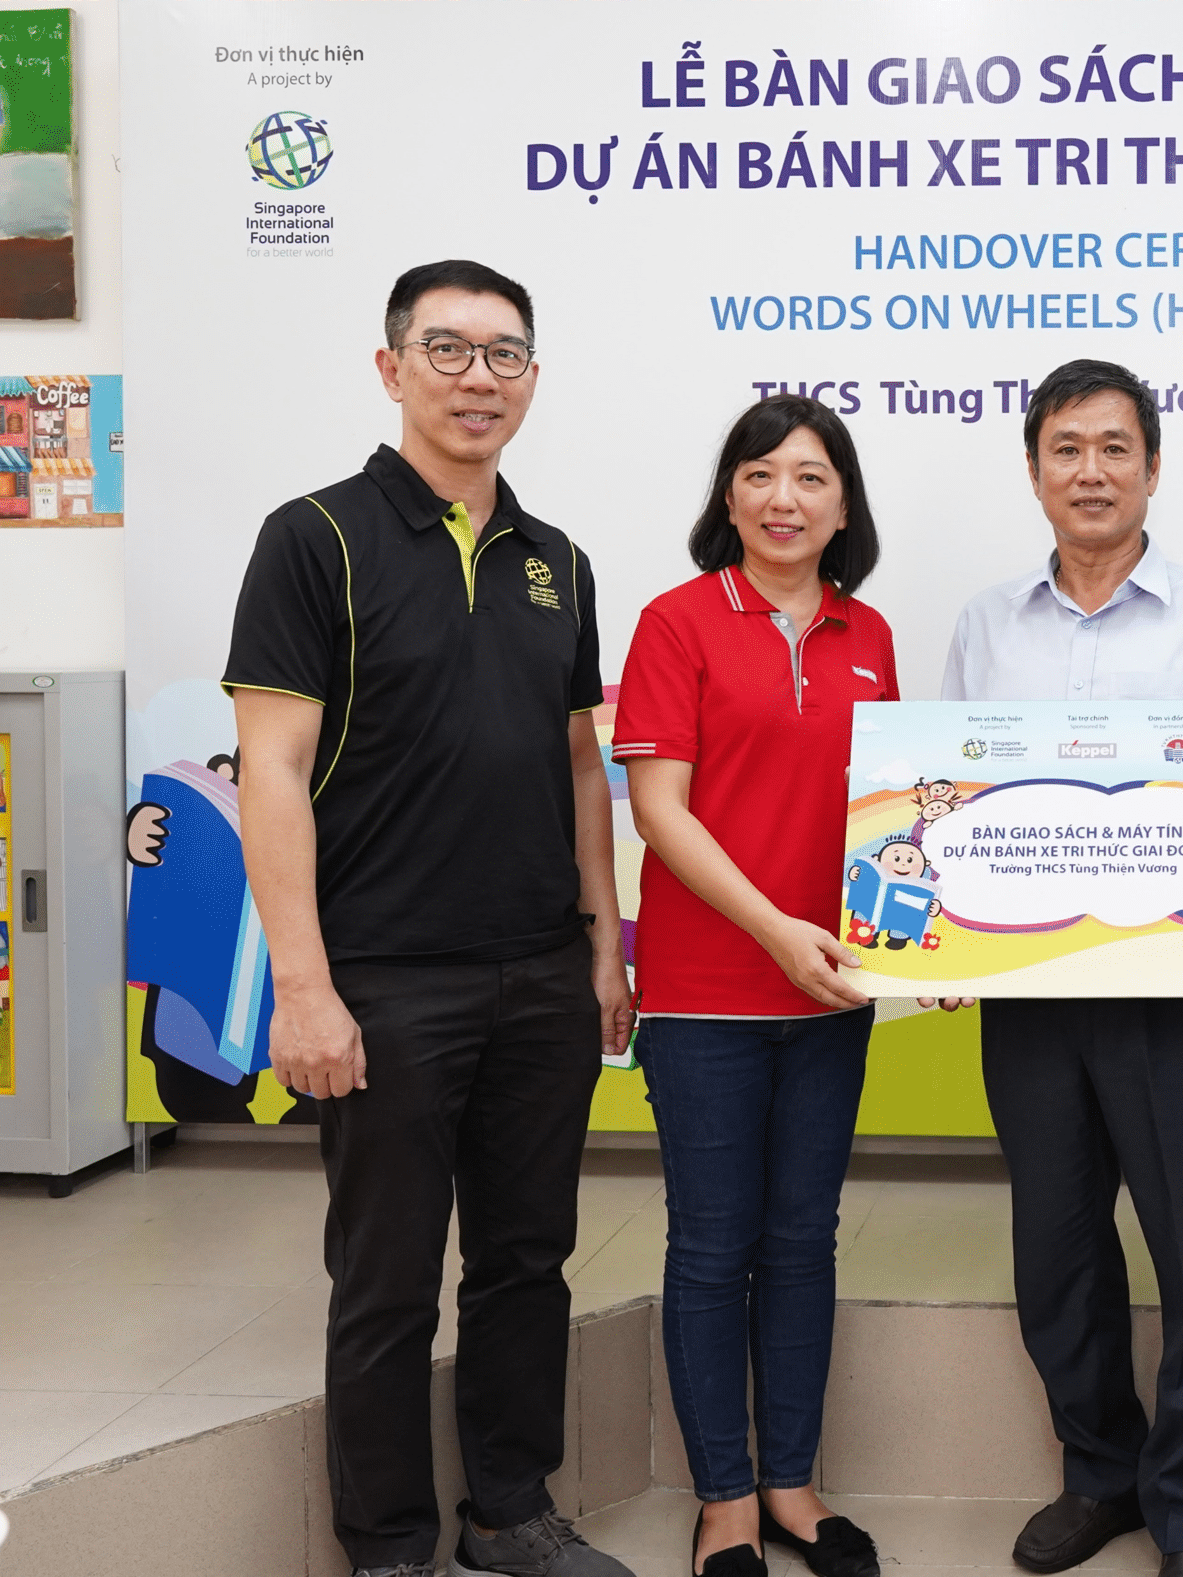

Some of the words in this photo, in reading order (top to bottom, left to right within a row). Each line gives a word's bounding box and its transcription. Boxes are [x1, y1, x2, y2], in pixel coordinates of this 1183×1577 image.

[215, 47, 252, 62] Đơn
[259, 47, 272, 65] vị
[279, 46, 319, 65] thực
[325, 45, 363, 65] hiện
[248, 73, 257, 84] A
[262, 73, 311, 88] project
[316, 72, 332, 88] by
[642, 41, 705, 108] LỄ
[725, 49, 848, 107] BÀN
[868, 56, 1021, 105] GIAO
[527, 135, 619, 204] DỰ
[632, 132, 717, 189] ÁN
[739, 131, 908, 189] BÁNH
[927, 139, 1001, 186] XE
[1015, 138, 1108, 185] TRI
[254, 202, 325, 216] Singapore
[247, 216, 333, 229] International
[251, 232, 329, 244] Foundation
[247, 247, 260, 257] for
[273, 248, 302, 257] better
[305, 248, 333, 257] world
[855, 233, 1102, 270] HANDOVER
[710, 295, 872, 331] WORDS
[885, 295, 949, 330] ON
[962, 293, 1138, 329] WHEELS
[37, 381, 90, 409] Coffee
[880, 380, 982, 424] Tùng
[1061, 740, 1115, 758] Keppel
[973, 825, 1005, 839] BÀN
[1010, 827, 1050, 839] GIAO
[1055, 824, 1097, 839] SÁCH
[1102, 827, 1113, 838] &
[1118, 824, 1152, 838] MÁY
[944, 845, 966, 860] DỰ
[970, 844, 990, 857] ÁN
[995, 844, 1036, 857] BÁNH
[1041, 846, 1058, 857] XE
[1062, 846, 1083, 856] TRI
[1088, 843, 1128, 856] THỨC
[1133, 845, 1162, 856] GIAI
[989, 864, 1031, 876] Trường
[1035, 864, 1066, 873] THCS
[1069, 864, 1098, 875] Tùng
[1102, 864, 1134, 875] Thiện
[1138, 864, 1177, 875] Vương
